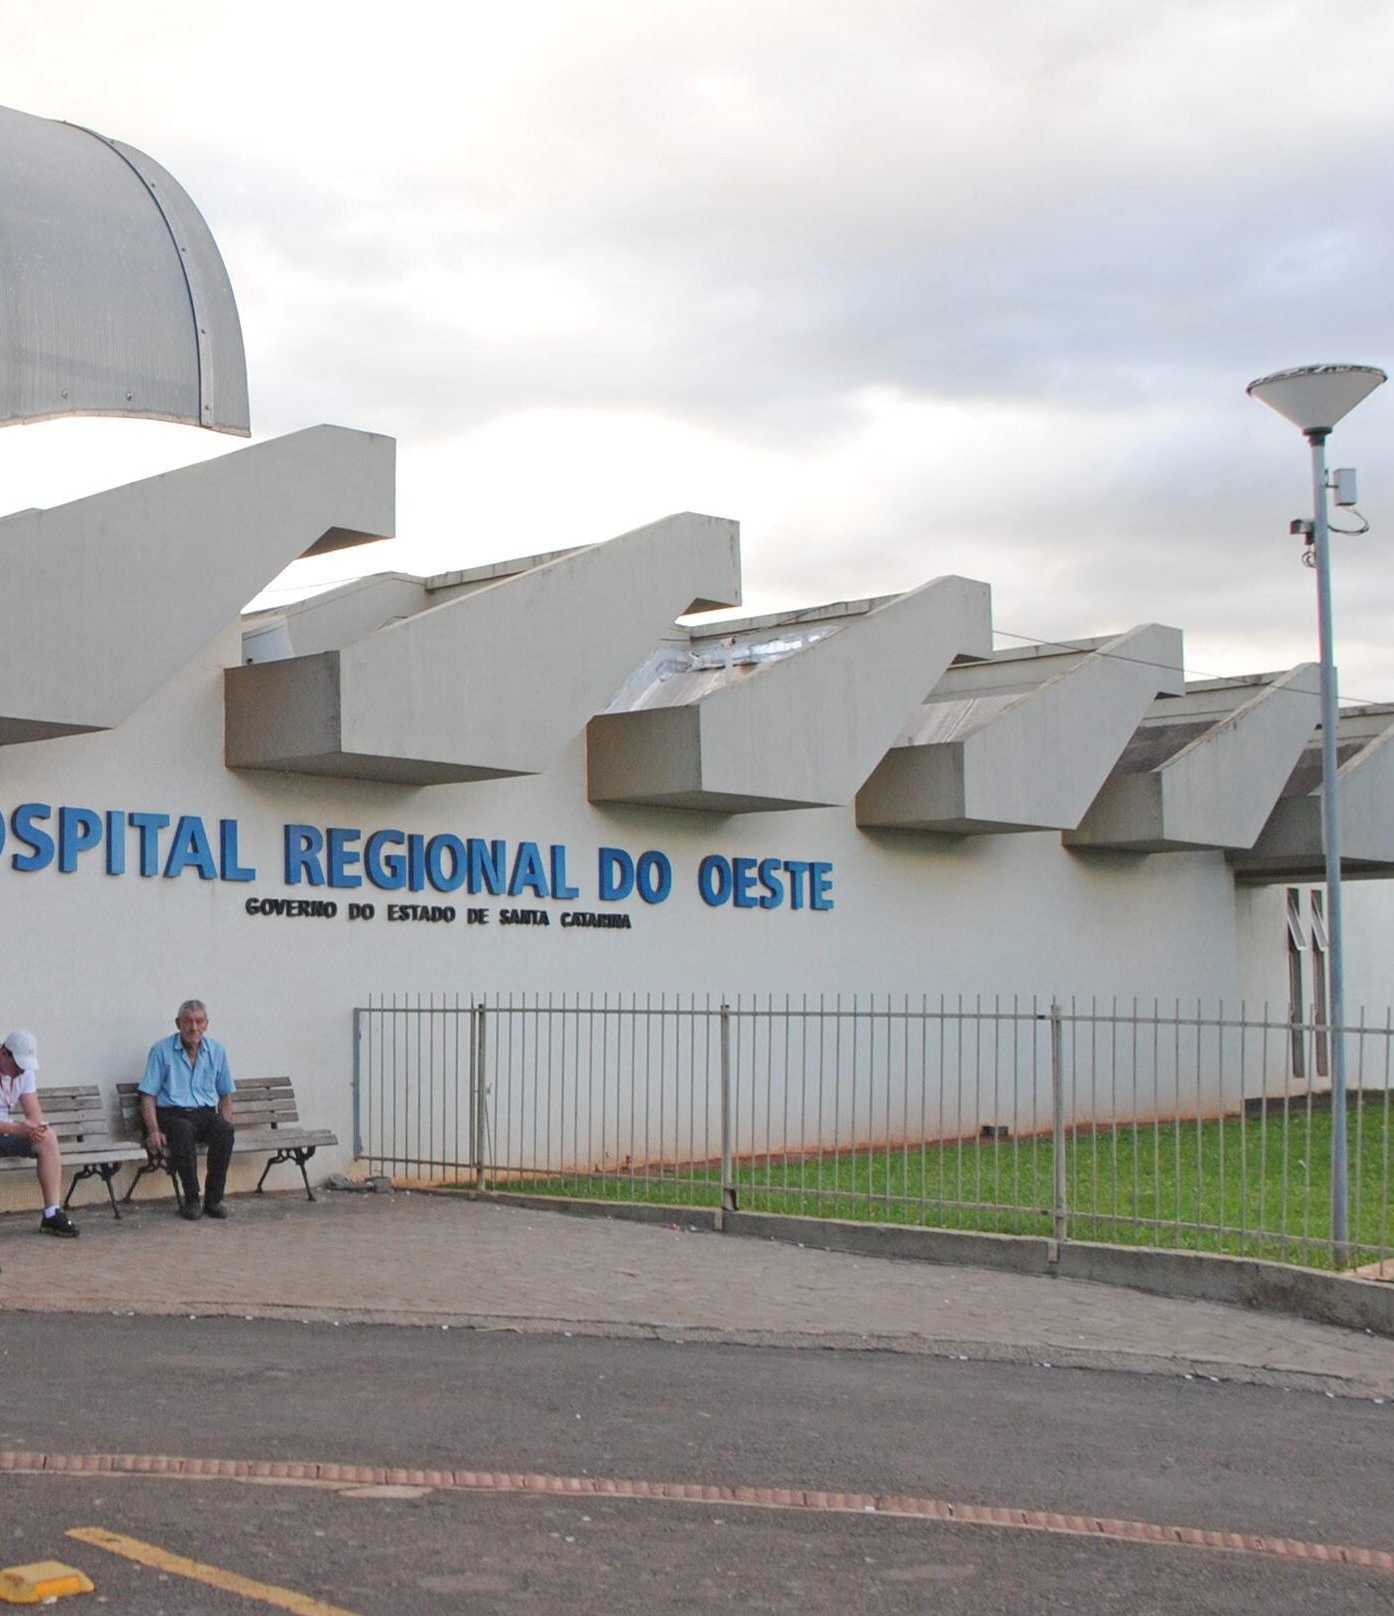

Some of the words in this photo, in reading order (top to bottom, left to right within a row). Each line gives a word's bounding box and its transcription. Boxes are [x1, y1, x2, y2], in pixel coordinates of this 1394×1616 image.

[284, 823, 580, 900] REGIONAL
[598, 846, 672, 905] DO
[697, 854, 835, 911] OESTE
[245, 898, 338, 918] GOVERNO
[348, 903, 375, 920] DO
[387, 904, 456, 923] ESTADO
[467, 908, 490, 925] DE
[499, 909, 550, 926] SANTA
[560, 912, 632, 929] CATARINA
